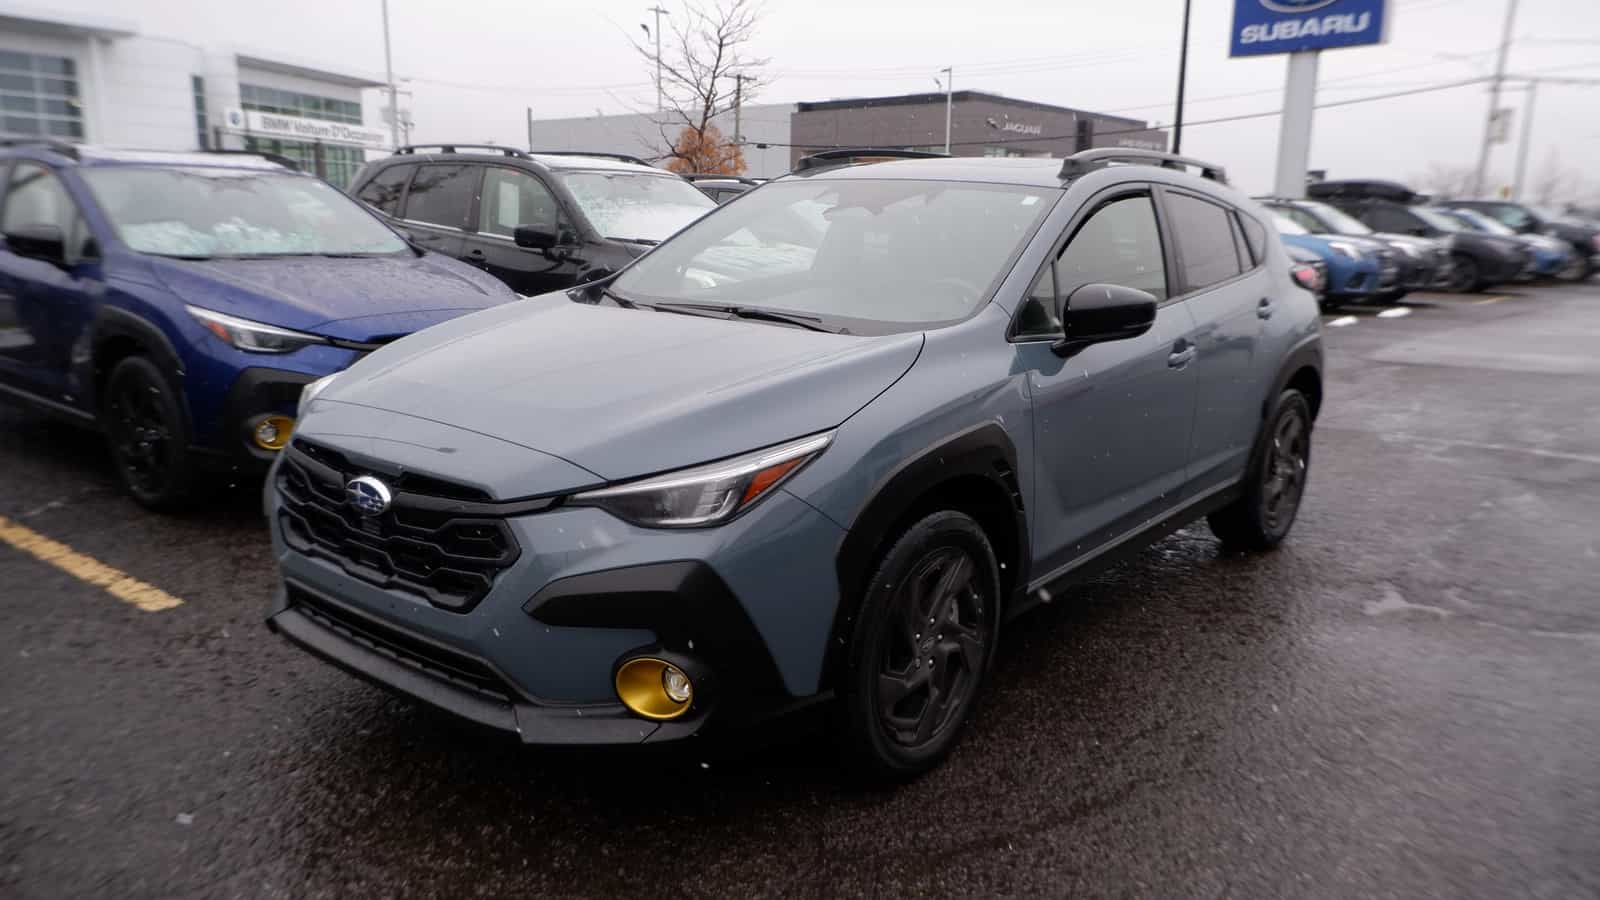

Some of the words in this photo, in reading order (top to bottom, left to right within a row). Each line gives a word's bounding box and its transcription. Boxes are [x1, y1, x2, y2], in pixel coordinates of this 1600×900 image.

[1240, 11, 1371, 44] SUBARU
[262, 115, 290, 130] BMW
[1002, 121, 1041, 136] JAGUAR
